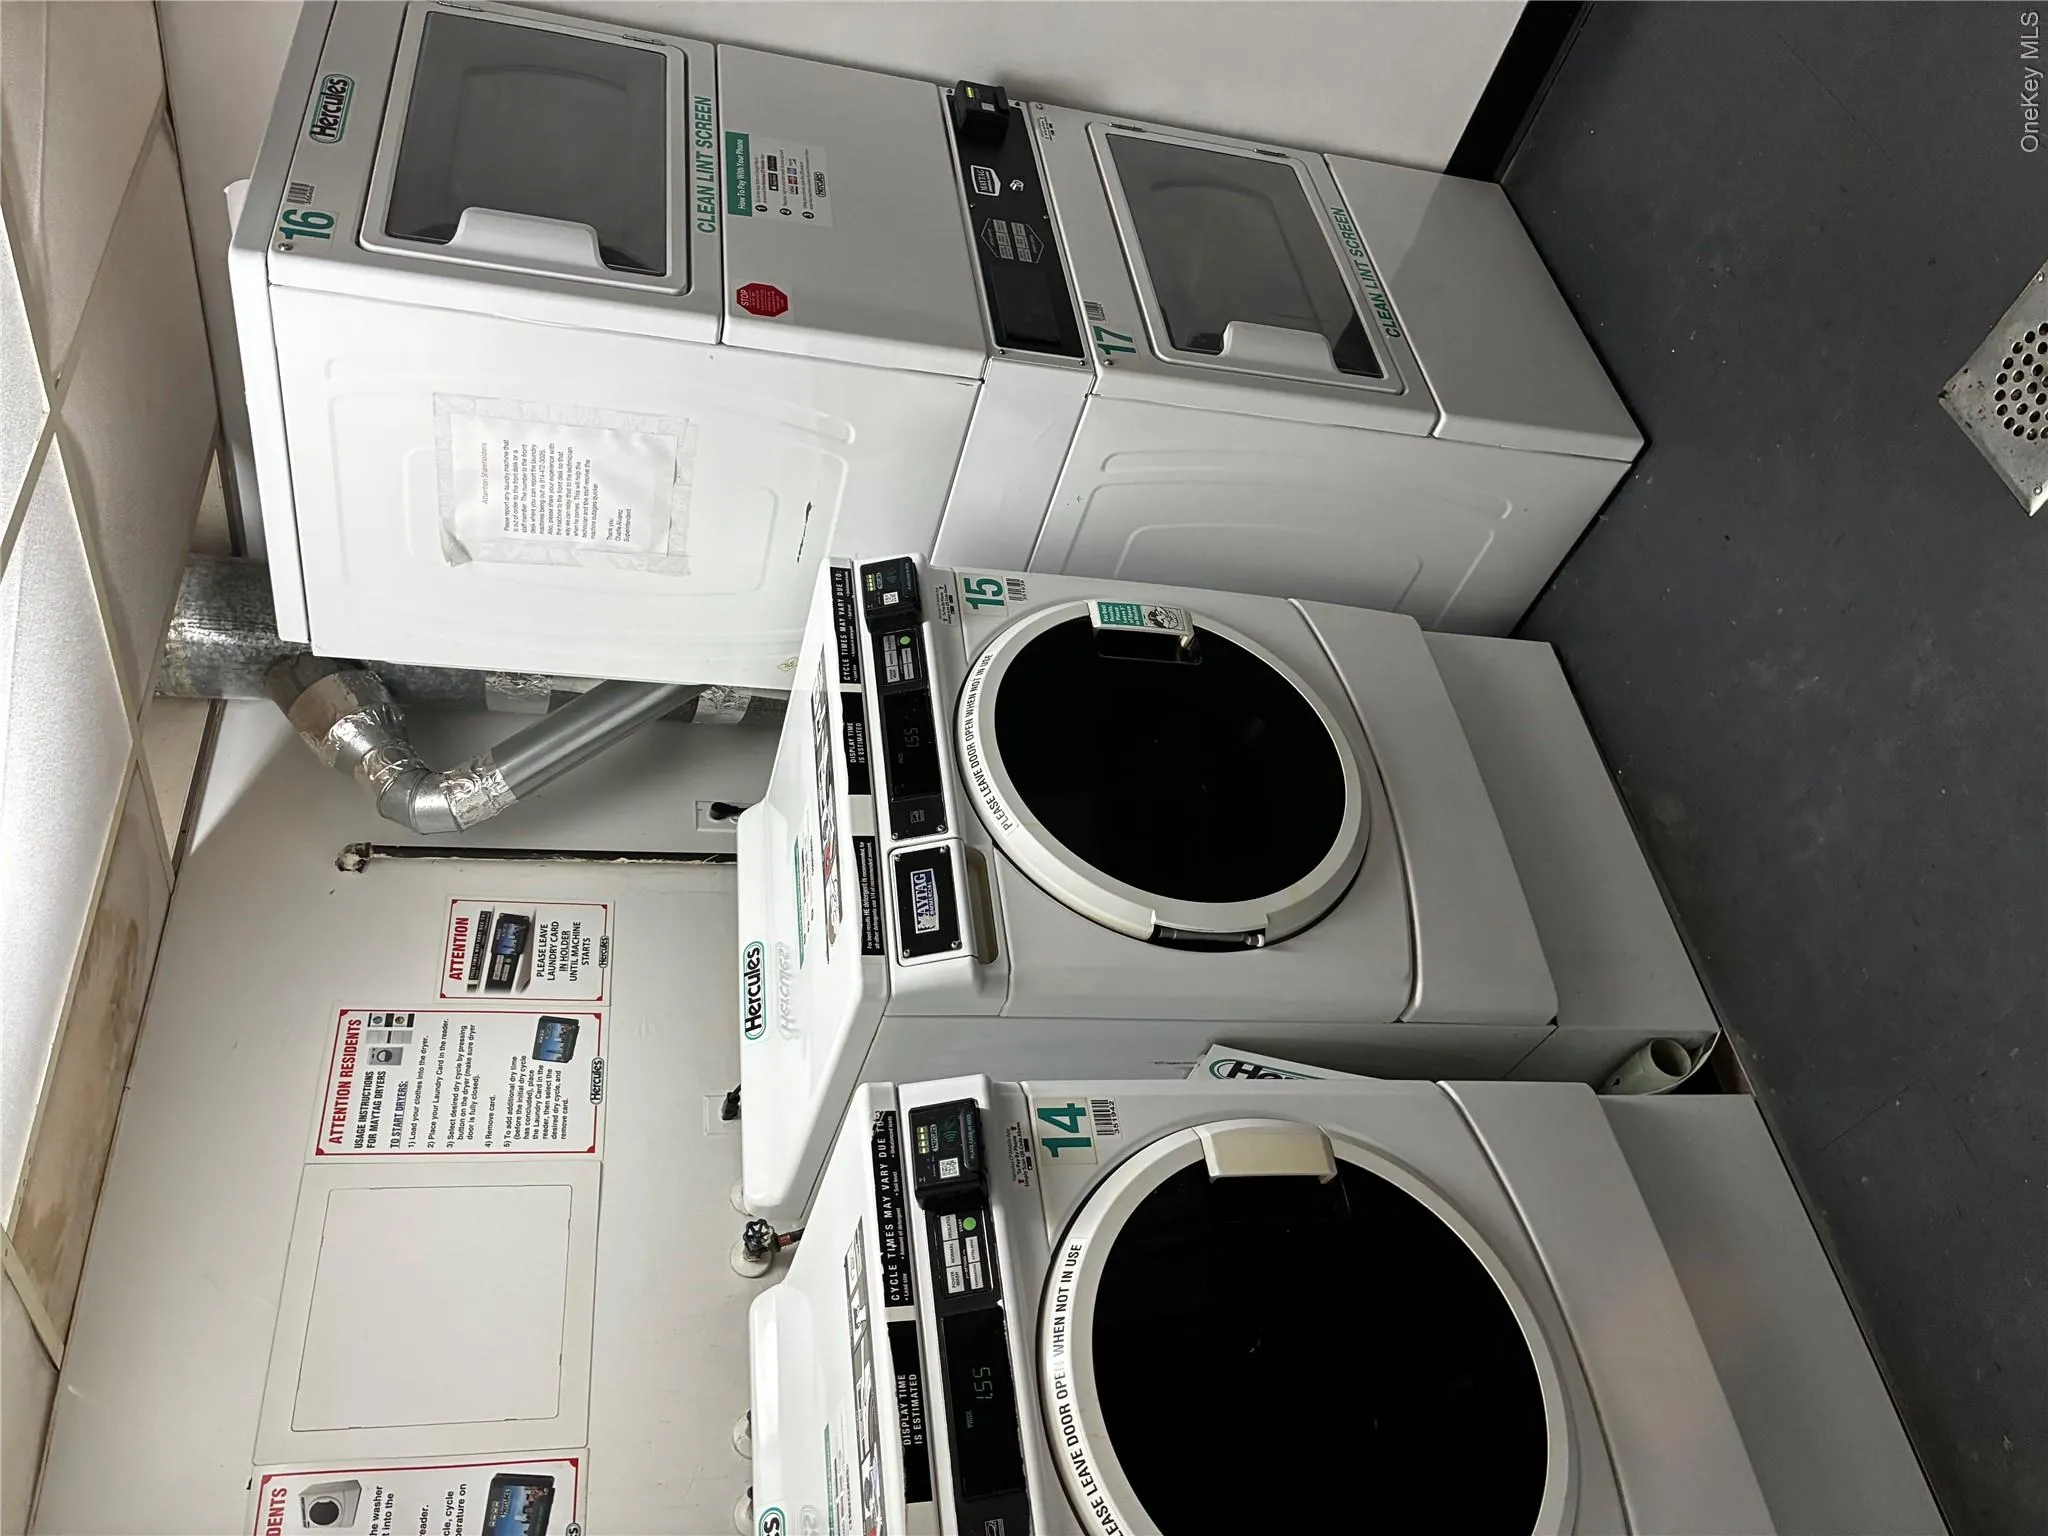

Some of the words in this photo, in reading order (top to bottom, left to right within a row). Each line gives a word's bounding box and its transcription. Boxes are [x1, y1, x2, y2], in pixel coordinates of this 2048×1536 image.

[311, 79, 348, 137] Hercules
[694, 96, 713, 149] SCREEN
[695, 152, 714, 182] LINT
[736, 155, 744, 166] Your
[736, 167, 744, 179] With
[737, 180, 746, 189] Pay
[977, 169, 988, 191] MAYTAG
[696, 185, 716, 233] CLEAN
[738, 197, 746, 209] How
[279, 209, 335, 240] 16
[1331, 208, 1363, 257] SCREEN
[1354, 260, 1378, 289] LINT
[740, 289, 749, 306] STOP
[1369, 293, 1400, 338] CLEAN
[1093, 326, 1136, 355] 17
[964, 578, 1004, 610] 15
[837, 599, 845, 615] VARY
[840, 635, 848, 655] TIMES
[842, 659, 850, 680] CYCLE
[976, 667, 985, 676] IN
[980, 654, 993, 666] USE
[971, 676, 980, 692] NOT
[965, 693, 976, 717] WHEN
[856, 723, 864, 755] ESTIMATED
[965, 718, 974, 741] OPEN
[848, 738, 856, 763] DISPLAY
[967, 742, 980, 766] DOOR
[973, 768, 992, 795] LEAVE
[986, 796, 1012, 830] PLEASE
[861, 883, 870, 907] detergent
[539, 924, 548, 947] LEAVE
[550, 921, 559, 942] CARD
[571, 922, 581, 956] MACHINE
[449, 917, 469, 980] ATTENTION
[560, 931, 570, 961] HOLDER
[581, 938, 590, 965] STARTS
[600, 938, 608, 965] Hercules
[537, 949, 547, 977] PLEASE
[547, 944, 558, 980] LAUNDRY
[559, 963, 568, 971] IN
[569, 959, 579, 981] UNTIL
[744, 947, 762, 1032] Hercules
[440, 1018, 449, 1039] reader.
[456, 1026, 467, 1052] pressing
[466, 1025, 476, 1040] dryer
[418, 1036, 428, 1054] dryer.
[438, 1041, 446, 1051] the
[466, 1042, 474, 1055] sure
[417, 1055, 426, 1065] the
[435, 1060, 444, 1075] Card
[453, 1063, 462, 1079] cycle
[464, 1057, 473, 1076] (make
[510, 1056, 518, 1070] time
[329, 1081, 351, 1144] ATTENTION
[340, 1019, 361, 1077] RESIDENTS
[374, 1071, 386, 1099] DRYERS
[416, 1067, 424, 1079] into
[509, 1072, 518, 1082] dry
[591, 1060, 602, 1100] Hercules
[358, 1071, 374, 1122] INSTRUCTIONS
[395, 1081, 408, 1111] DRYERS:
[413, 1081, 423, 1105] clothes
[433, 1077, 443, 1103] Laundry
[451, 1081, 461, 1092] dry
[462, 1078, 471, 1095] dryer
[471, 1074, 480, 1100] closed).
[449, 1093, 459, 1117] desired
[460, 1097, 469, 1106] the
[470, 1101, 478, 1115] fully
[488, 1094, 496, 1111] card.
[507, 1084, 515, 1115] additional
[370, 1101, 382, 1131] MAYTAG
[412, 1107, 421, 1121] your
[431, 1105, 439, 1120] your
[460, 1108, 468, 1117] on
[1109, 1101, 1120, 1134] 351942
[354, 1124, 366, 1148] USAGE
[392, 1113, 403, 1137] START
[409, 1123, 417, 1139] Load
[428, 1122, 437, 1139] Place
[447, 1119, 456, 1139] Select
[457, 1118, 467, 1140] button
[467, 1125, 475, 1140] door
[485, 1113, 494, 1139] Remove
[504, 1131, 512, 1139] To
[1037, 1103, 1092, 1158] 14
[367, 1134, 377, 1148] FOR
[390, 1138, 400, 1148] TO
[877, 1138, 887, 1158] DUE
[879, 1163, 890, 1190] VARY
[882, 1196, 892, 1218] MAY
[885, 1224, 897, 1258] TIMES
[1065, 1245, 1082, 1266] USE
[888, 1264, 900, 1301] CYCLE
[1061, 1271, 1073, 1282] IN
[1055, 1287, 1069, 1312] NOT
[1053, 1316, 1066, 1357] WHEN
[897, 1374, 908, 1398] TIME
[972, 1366, 994, 1399] 1.55
[1053, 1360, 1068, 1399] OPEN
[909, 1374, 922, 1430] ESTIMATED
[901, 1403, 911, 1445] DISPLAY
[1059, 1403, 1079, 1447] DOOR
[914, 1434, 923, 1444] IS
[1070, 1448, 1098, 1496] LEAVE
[385, 1494, 394, 1508] the
[459, 1484, 467, 1496] on
[372, 1486, 383, 1521] washer
[444, 1491, 454, 1516] cycle
[382, 1512, 392, 1530] into
